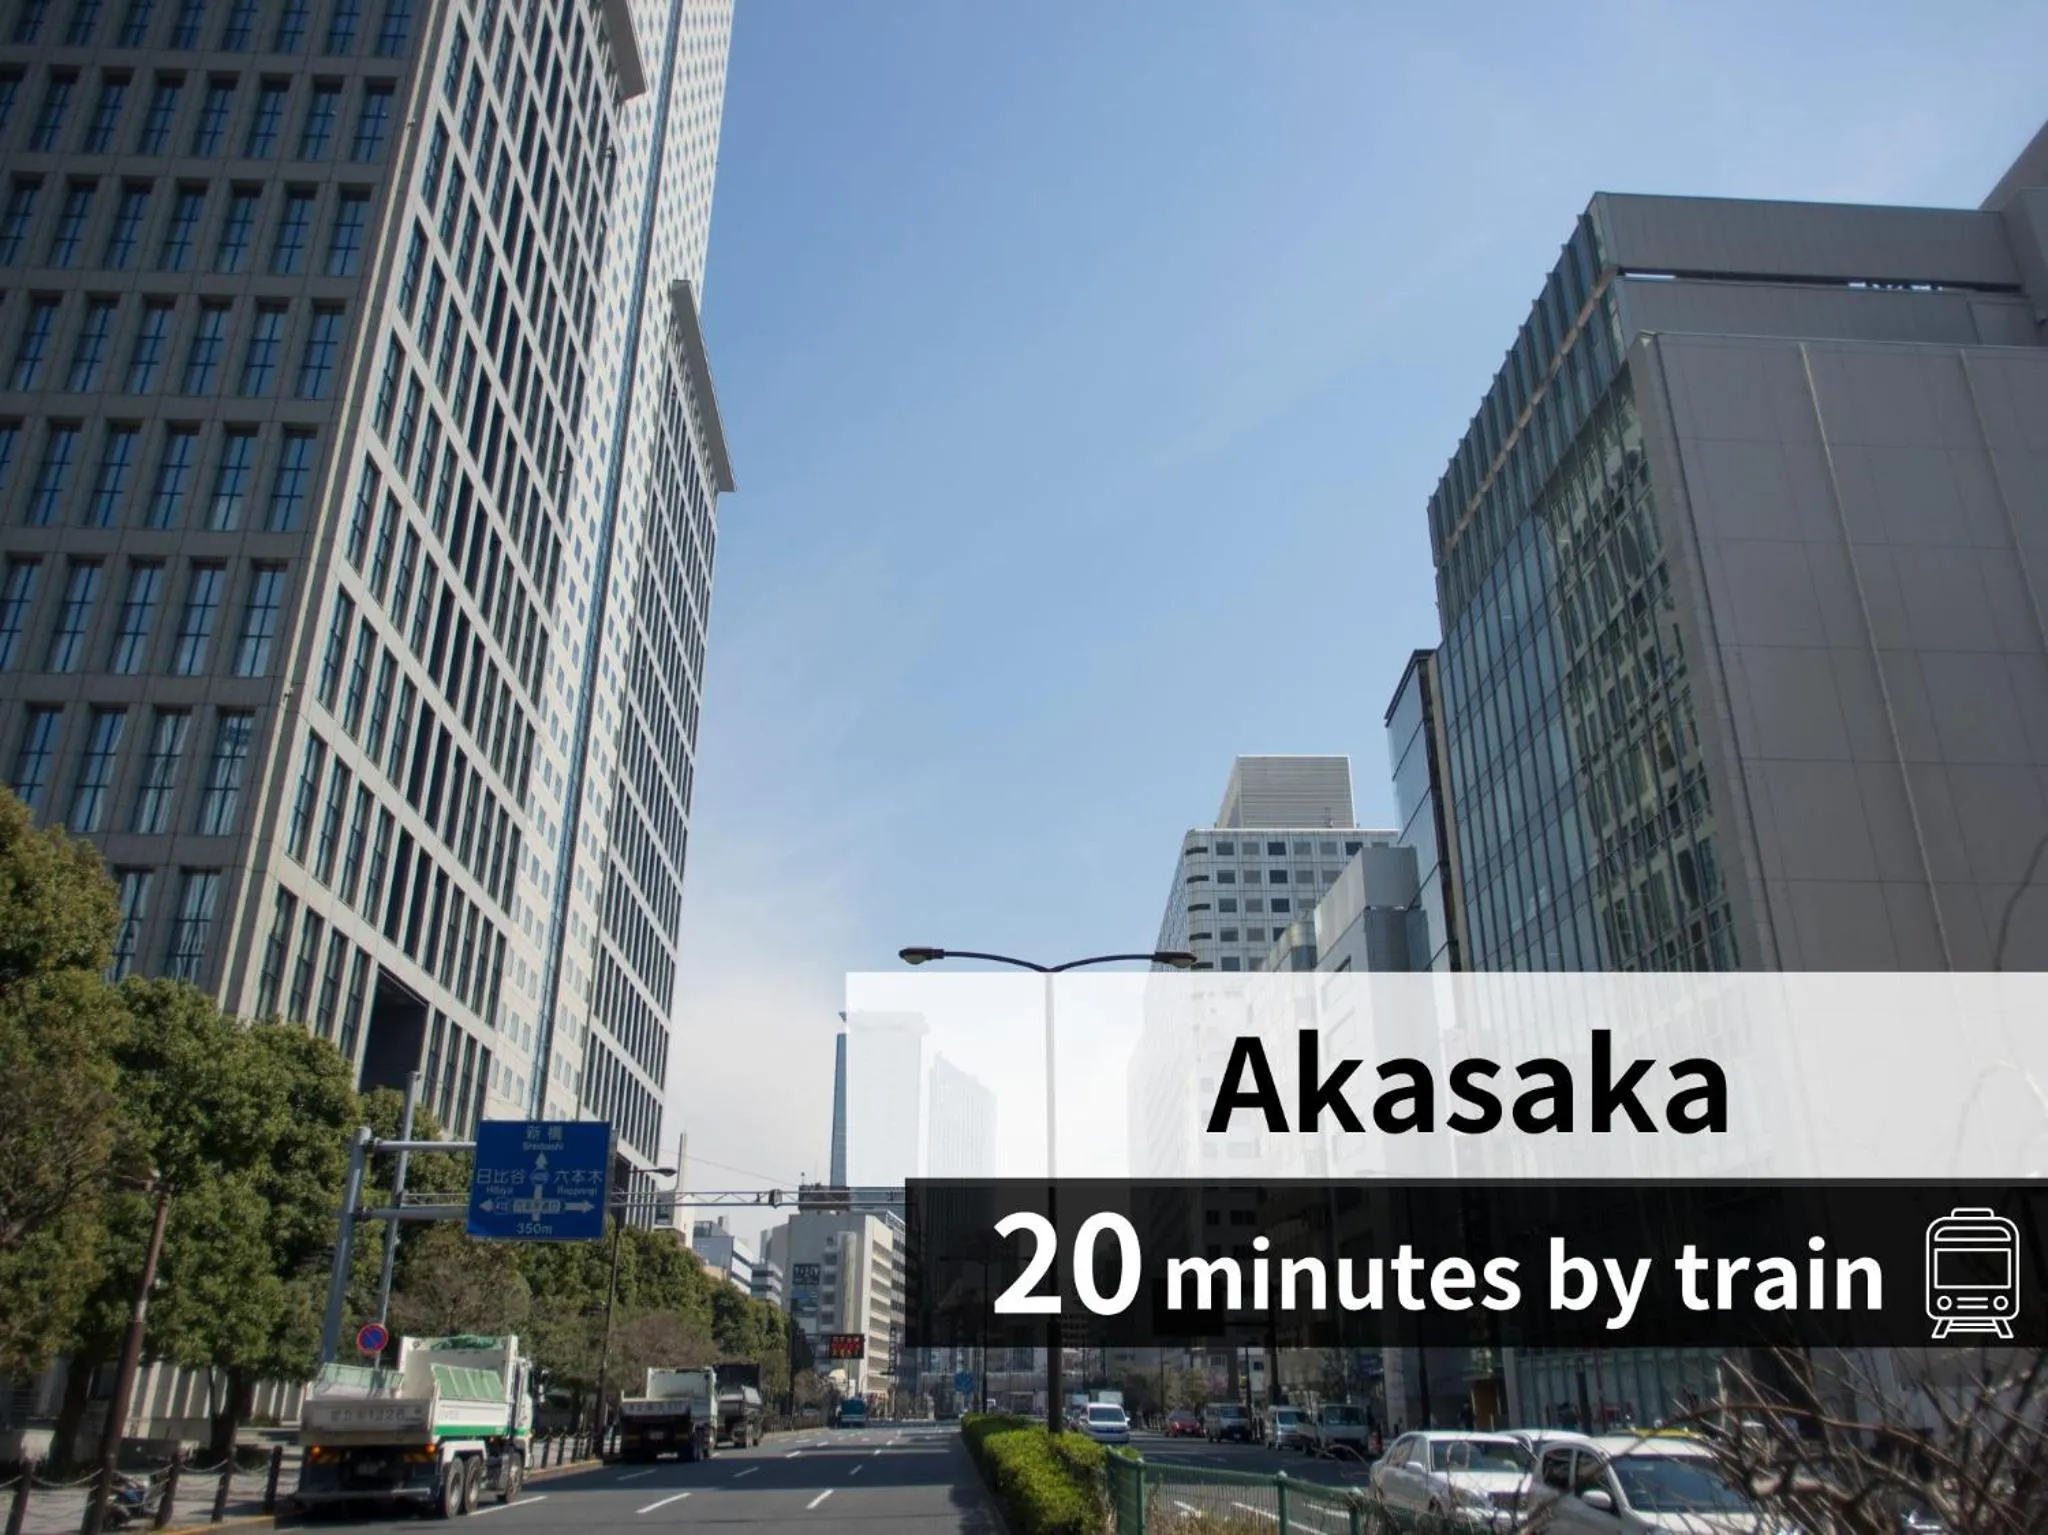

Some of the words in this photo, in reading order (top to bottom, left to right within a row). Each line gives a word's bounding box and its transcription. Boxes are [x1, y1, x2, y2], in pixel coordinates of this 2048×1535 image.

[477, 1168, 526, 1185] 日比谷
[553, 1168, 604, 1185] 六本木
[516, 1223, 553, 1235] 350m
